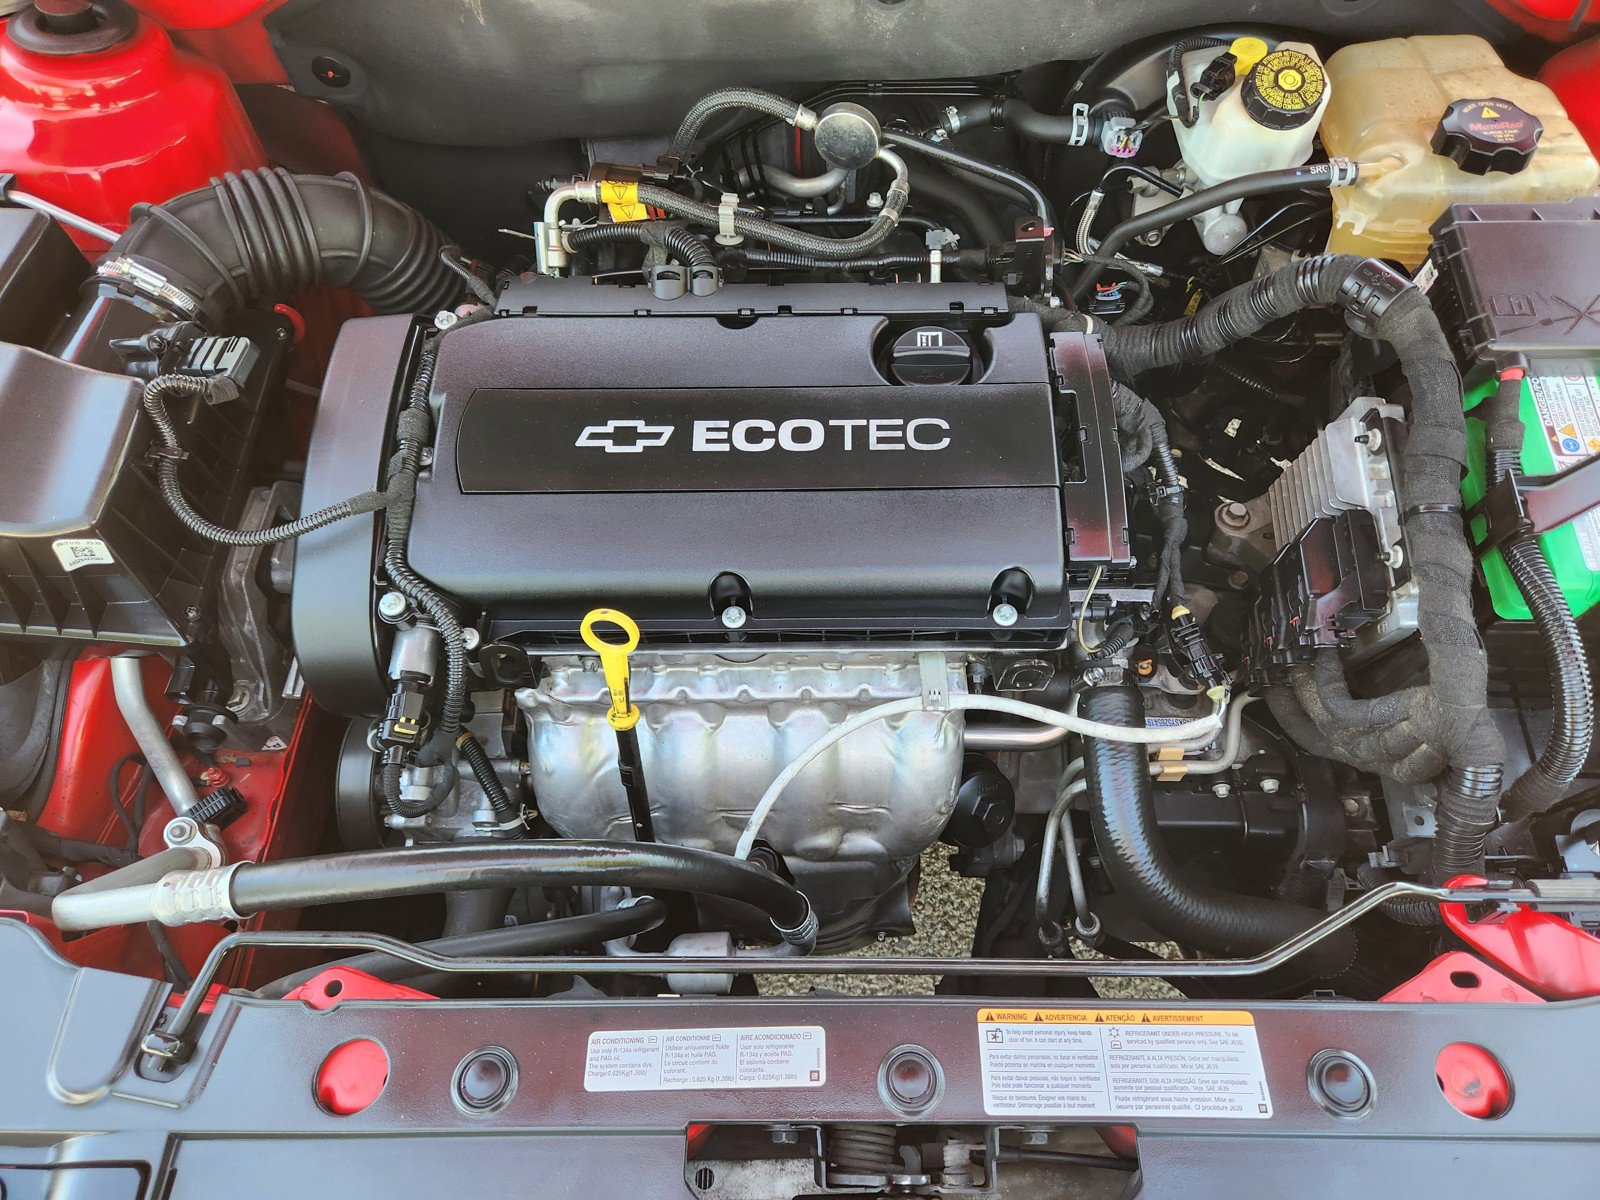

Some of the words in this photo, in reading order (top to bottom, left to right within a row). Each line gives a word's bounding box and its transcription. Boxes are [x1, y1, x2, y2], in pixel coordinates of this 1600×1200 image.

[692, 418, 950, 452] ECOTEC
[1105, 1014, 1136, 1022] ATENÇÃO
[754, 1033, 802, 1041] ACONDICIONADO
[632, 1046, 660, 1054] refrigerant
[663, 1076, 688, 1084] Recharge
[739, 1074, 757, 1082] Carga:
